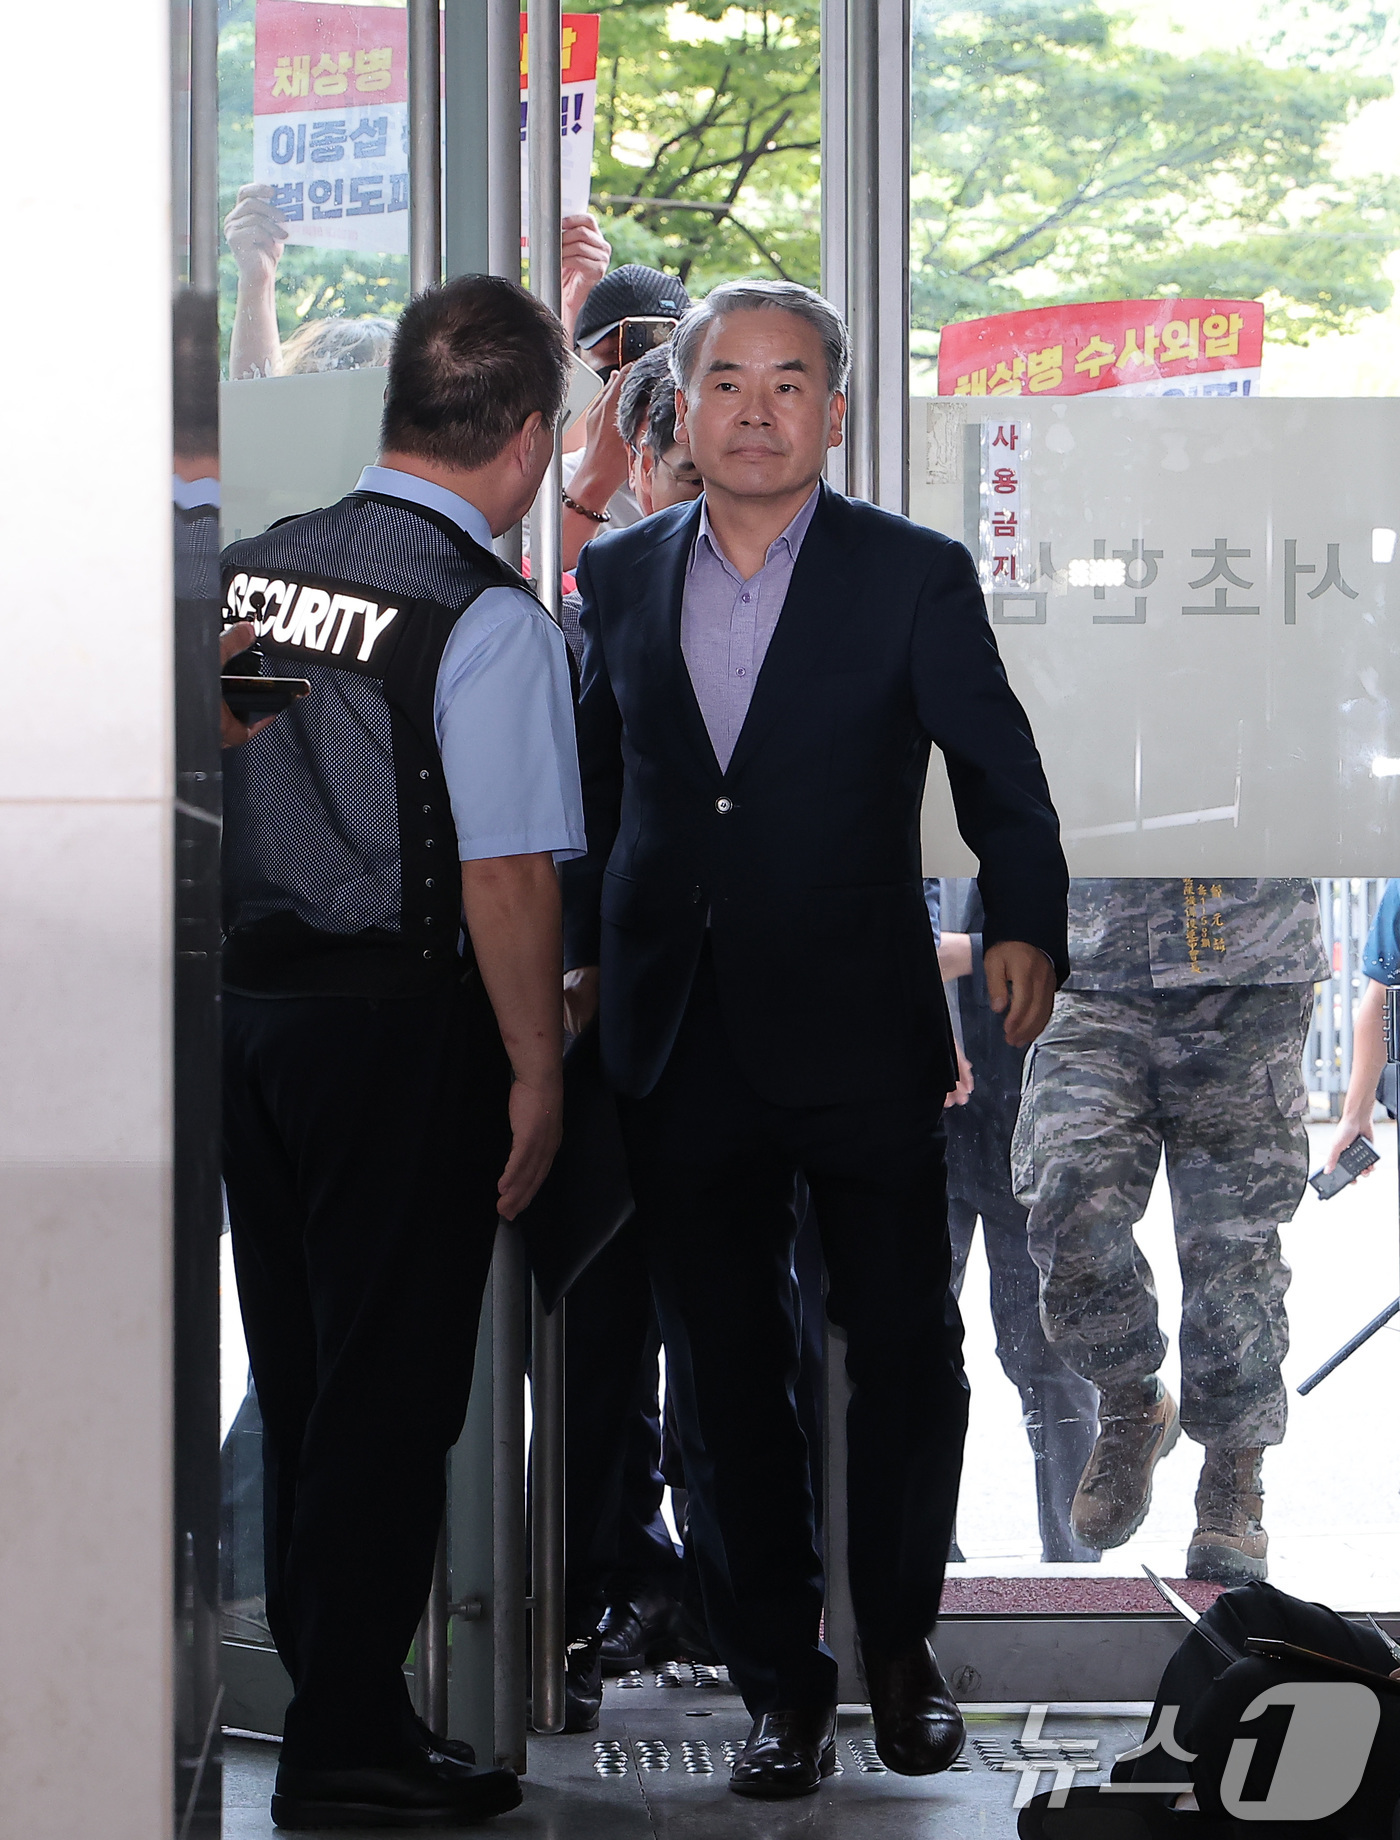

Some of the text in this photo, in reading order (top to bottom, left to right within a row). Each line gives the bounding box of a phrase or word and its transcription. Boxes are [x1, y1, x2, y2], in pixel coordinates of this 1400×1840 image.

[271, 47, 393, 98] 채상병
[271, 116, 388, 165] 이종섭
[1074, 313, 1244, 378] 수사외압
[992, 425, 1019, 581] 사용금지
[222, 573, 399, 662] SECURITY
